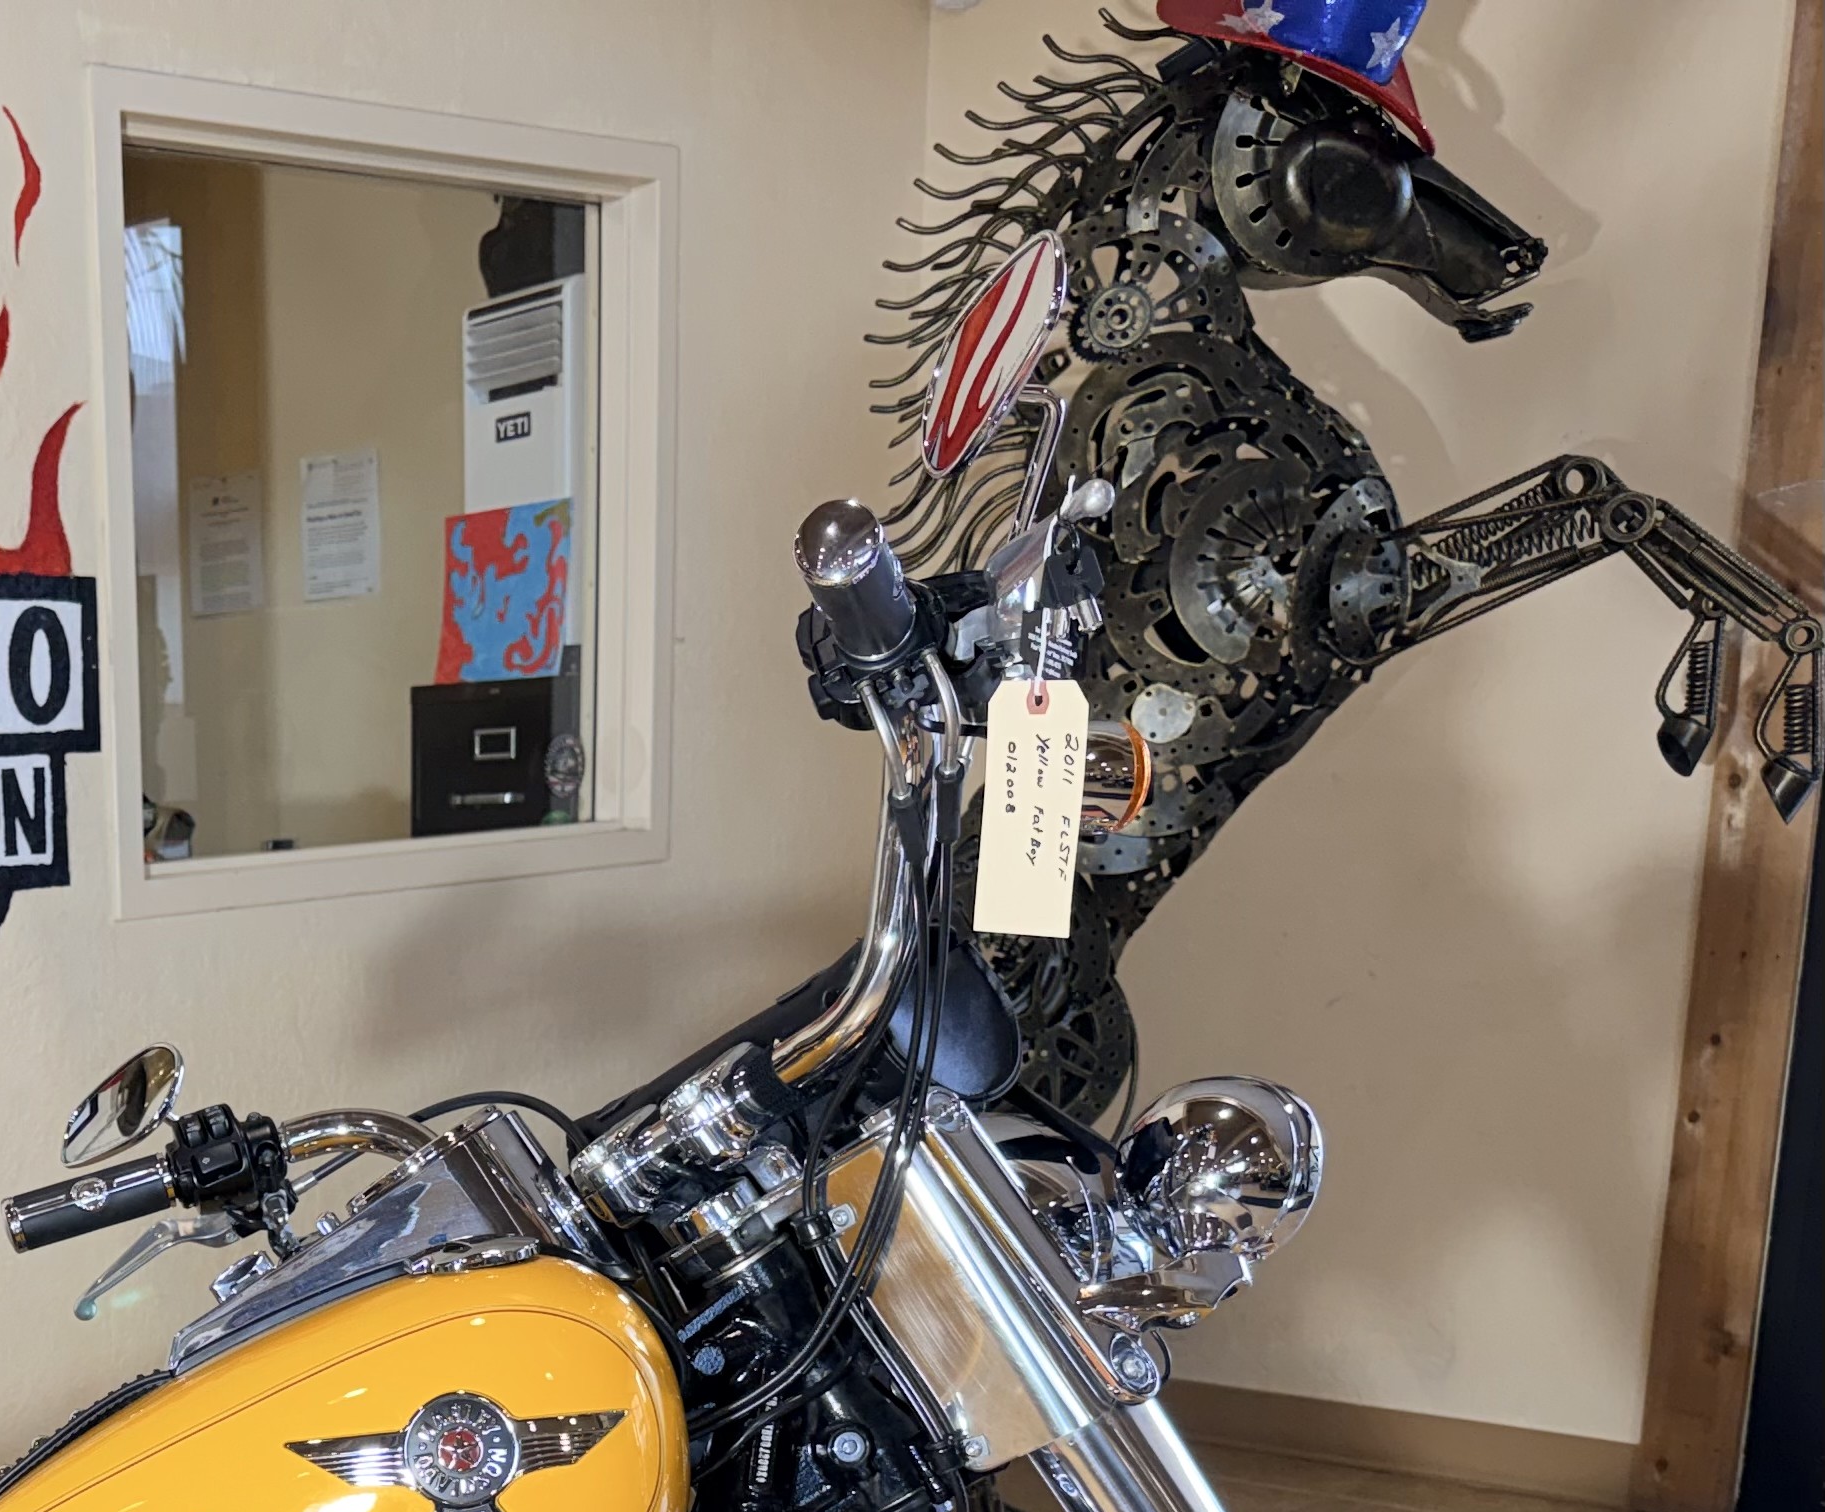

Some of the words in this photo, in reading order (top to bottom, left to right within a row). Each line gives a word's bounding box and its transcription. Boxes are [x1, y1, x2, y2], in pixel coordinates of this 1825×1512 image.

[496, 414, 529, 440] YETI
[1005, 741, 1017, 814] 012008
[1035, 733, 1052, 789] Yellow
[1063, 733, 1080, 785] 2011
[1058, 815, 1072, 882] FLSTF
